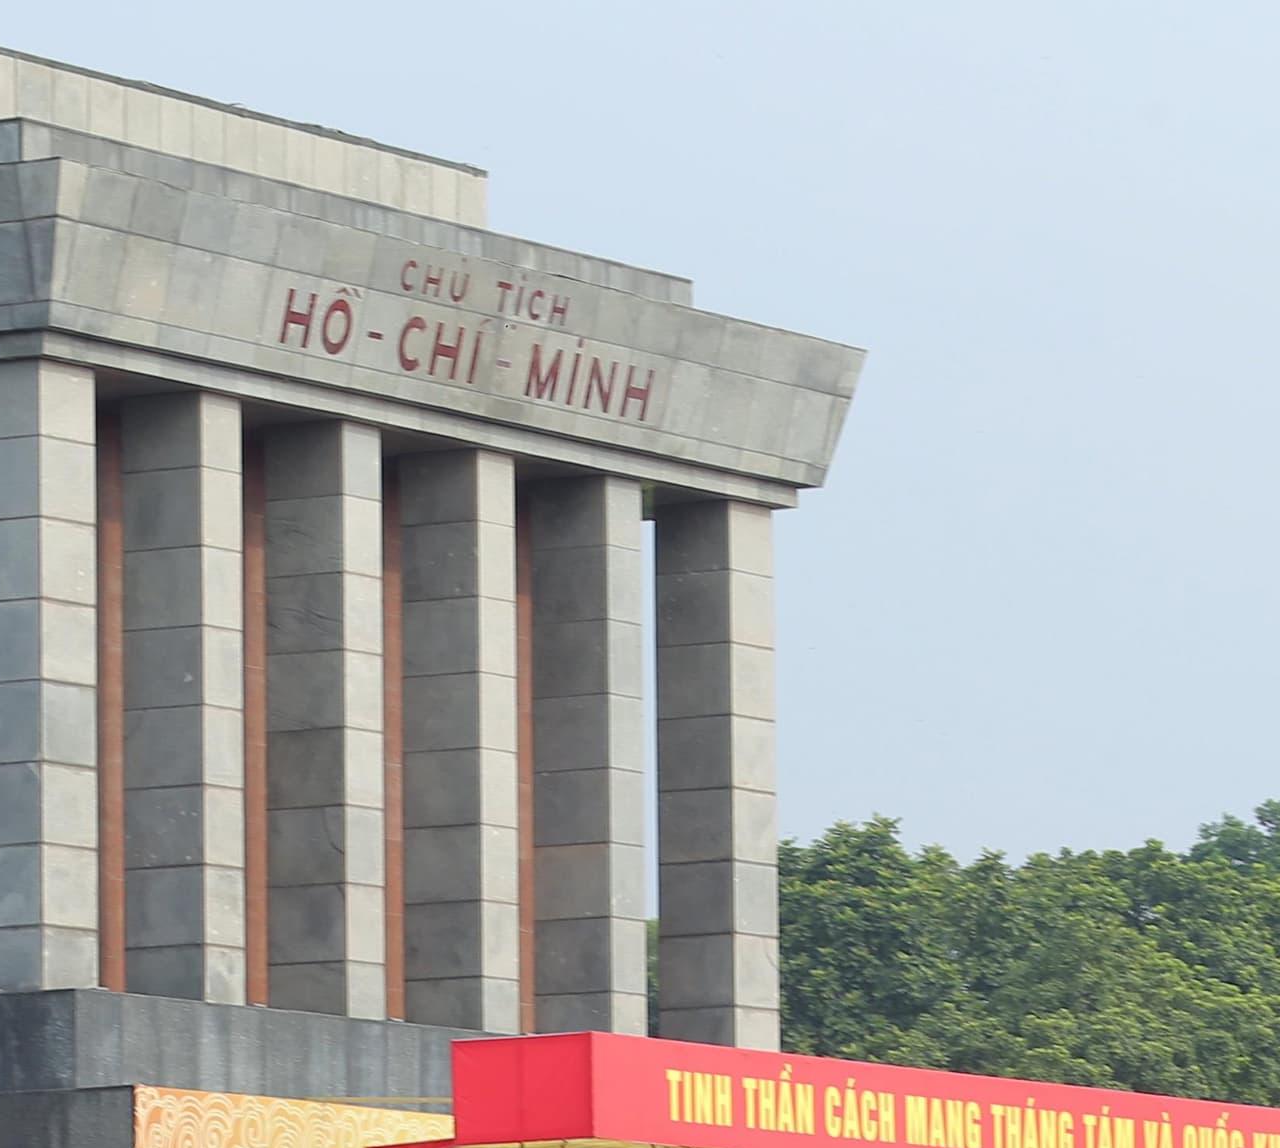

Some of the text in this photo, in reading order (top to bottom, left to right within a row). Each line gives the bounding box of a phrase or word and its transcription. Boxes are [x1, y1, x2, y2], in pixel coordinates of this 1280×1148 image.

[665, 1068, 733, 1127] TINH
[742, 1063, 816, 1135] THẦN
[824, 1078, 897, 1143] CÁCH
